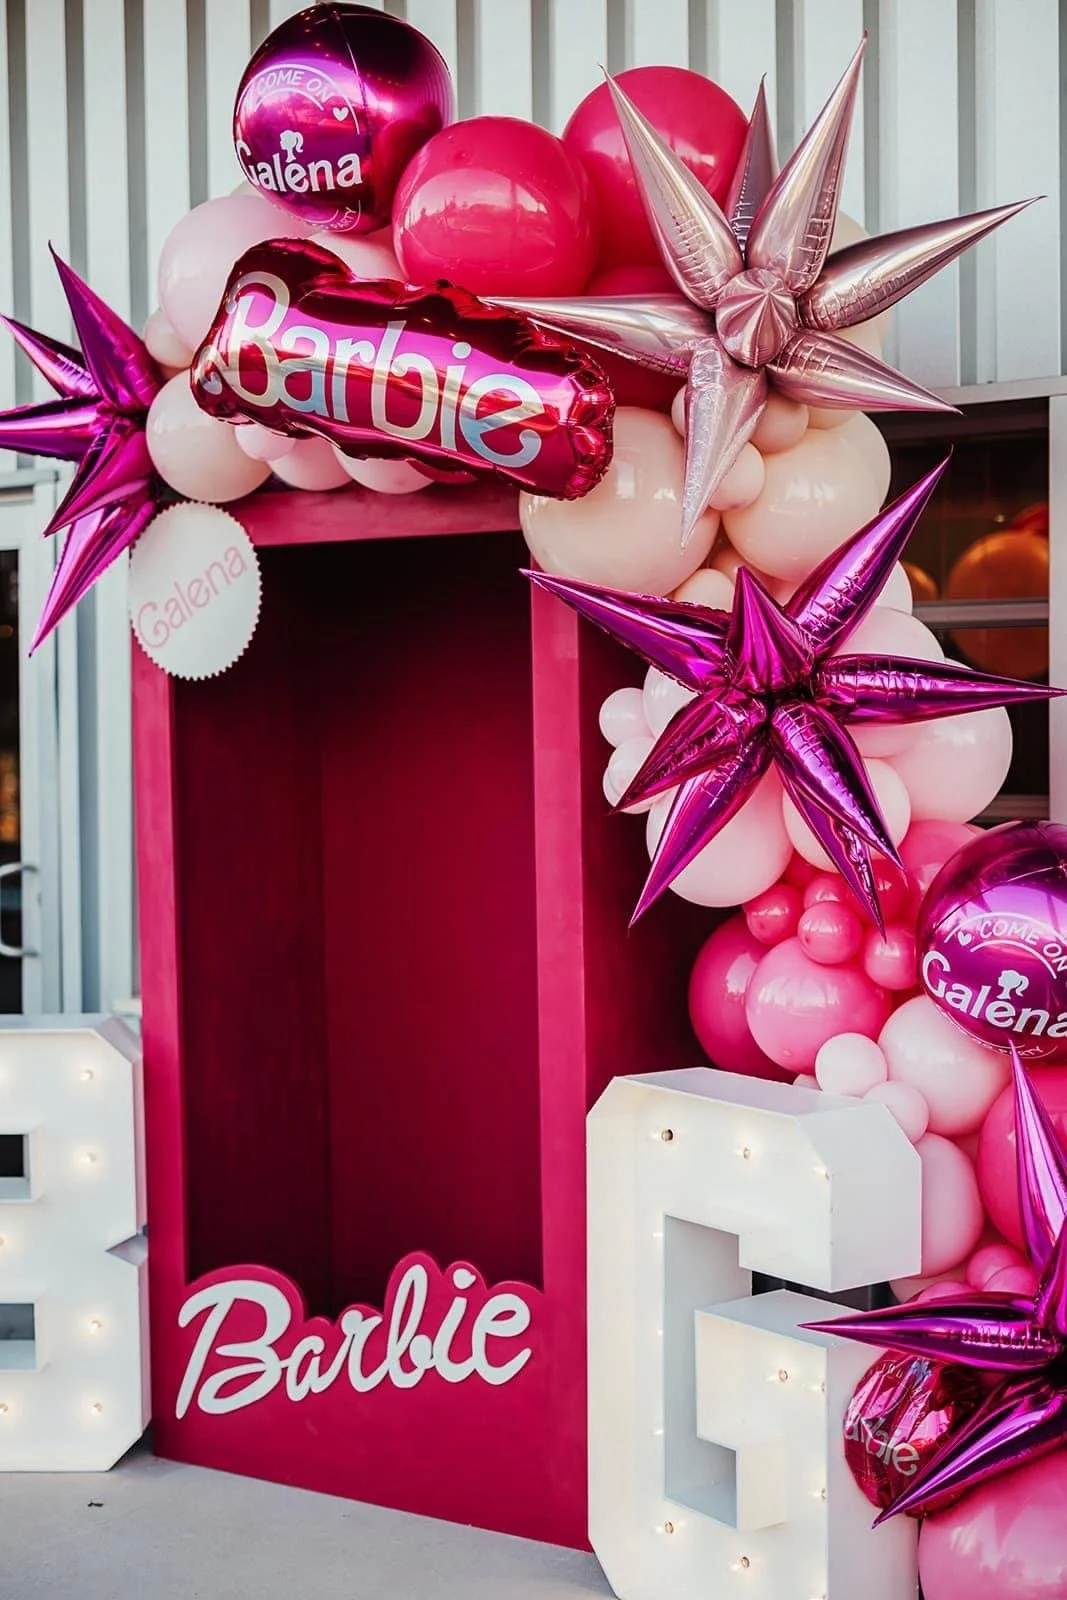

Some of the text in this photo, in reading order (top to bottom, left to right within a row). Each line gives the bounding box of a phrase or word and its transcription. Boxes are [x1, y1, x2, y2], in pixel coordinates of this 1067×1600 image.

[256, 69, 334, 104] COME ON
[236, 140, 363, 193] Galena
[200, 271, 545, 468] Barbie
[137, 545, 248, 648] Galena
[980, 919, 1040, 946] COME
[922, 950, 1067, 1038] Galena
[175, 1263, 532, 1420] Barbie
